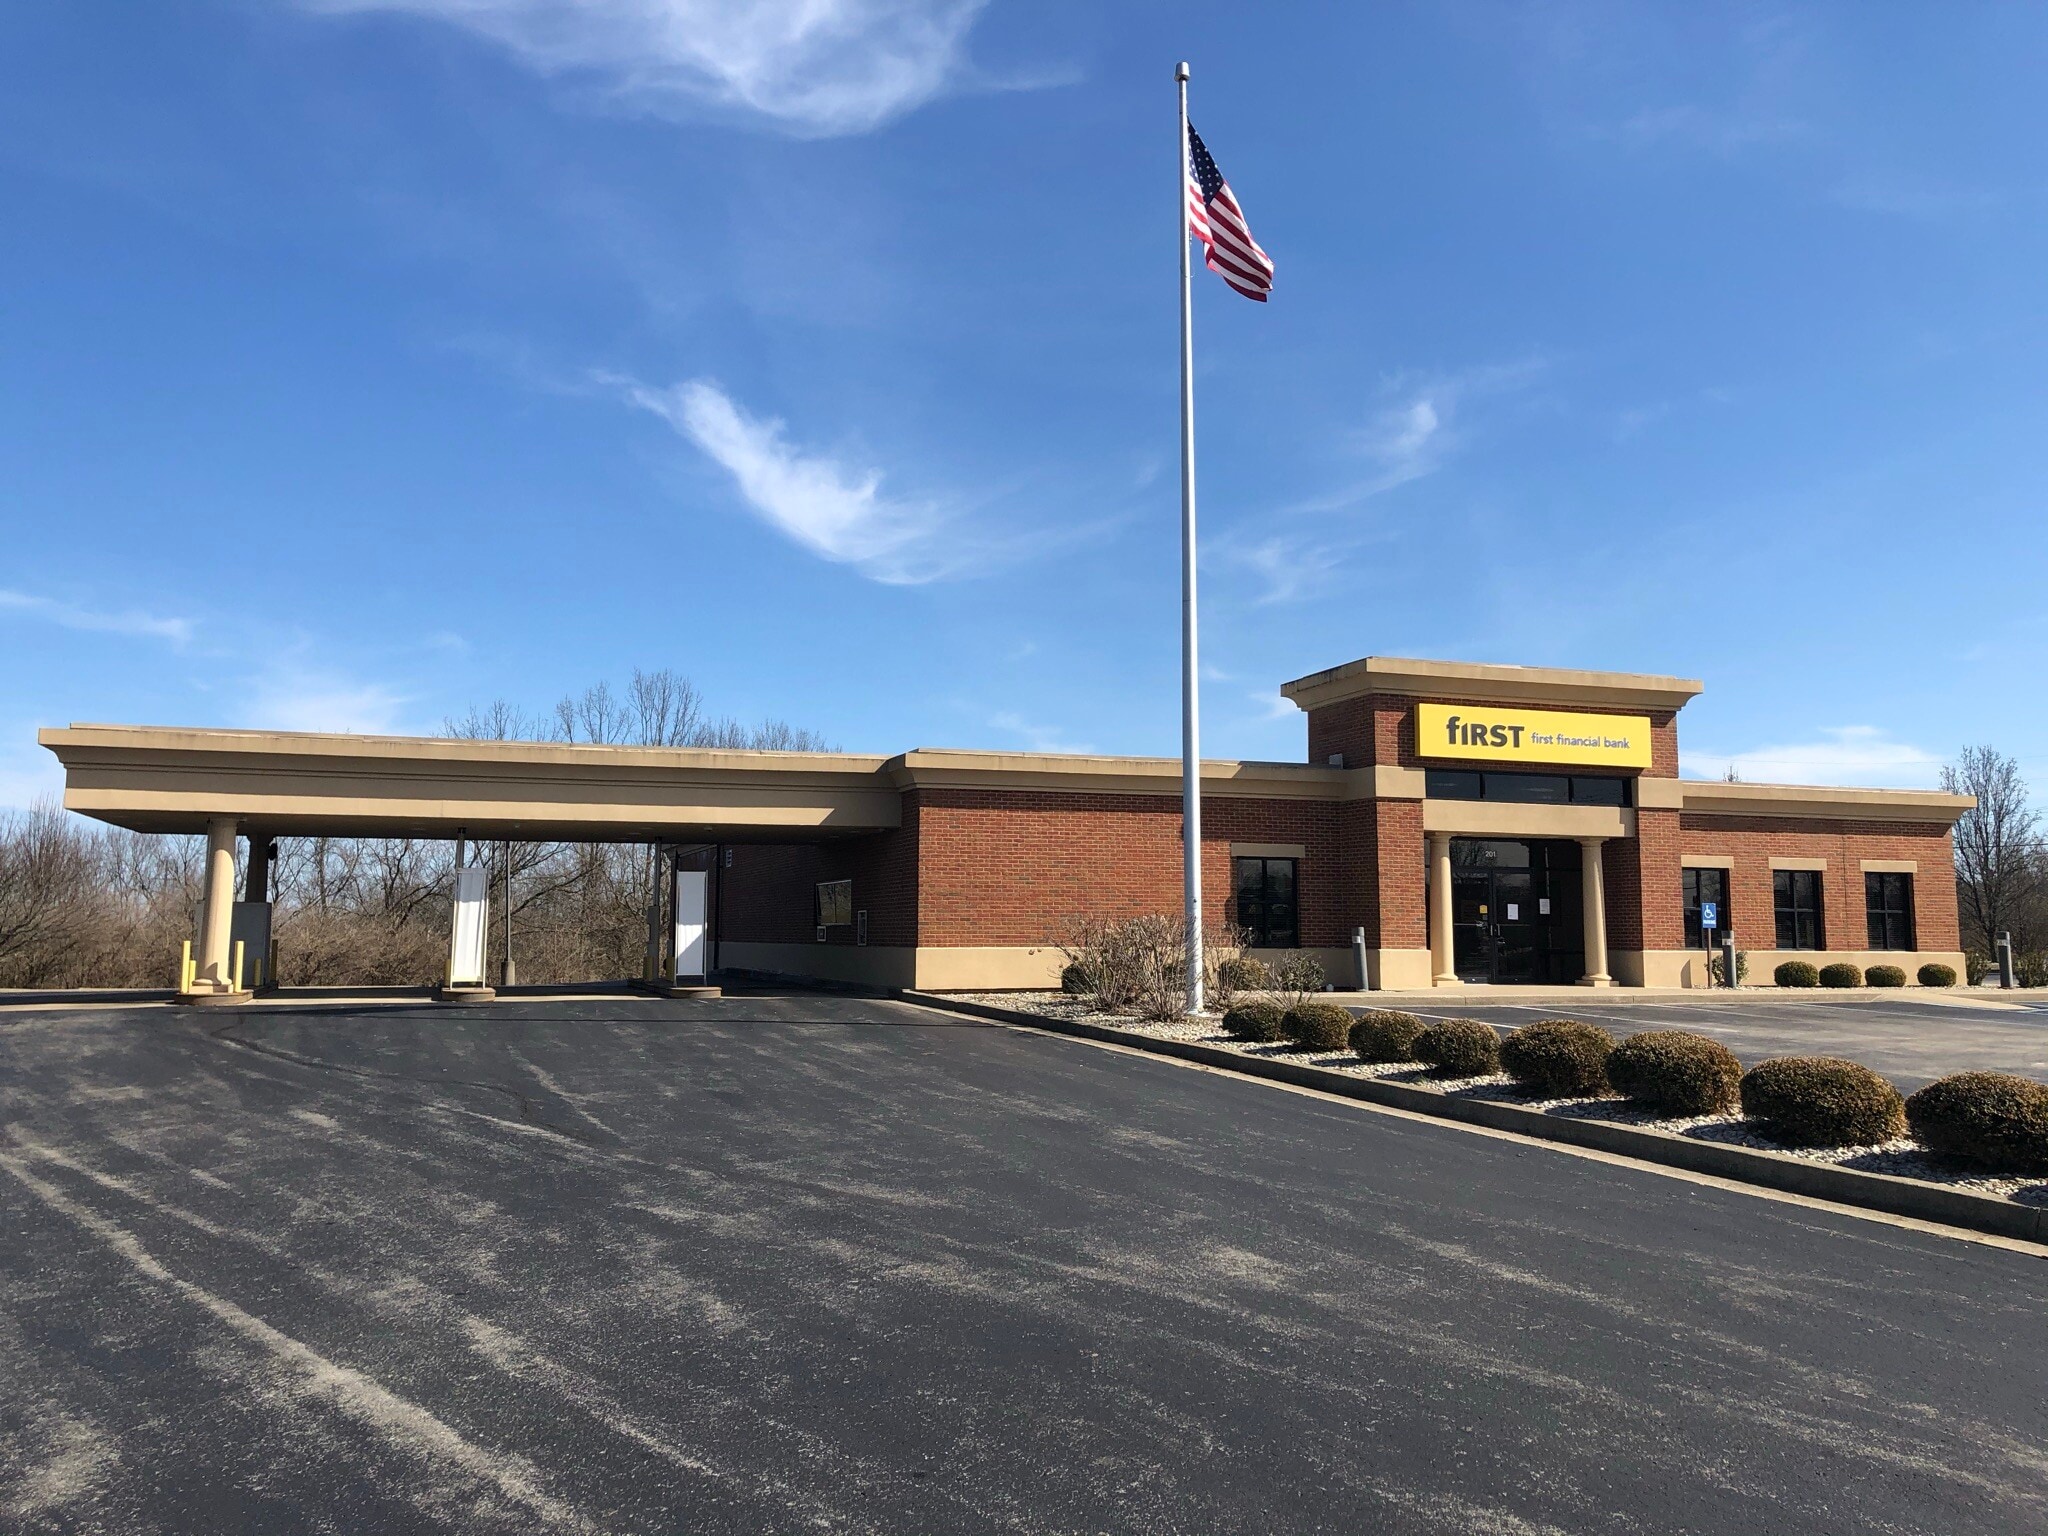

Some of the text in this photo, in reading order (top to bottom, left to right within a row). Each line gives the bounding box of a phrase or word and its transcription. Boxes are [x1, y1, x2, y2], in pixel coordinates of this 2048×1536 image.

[1531, 732, 1630, 749] first financial bank
[1485, 850, 1496, 858] 201
